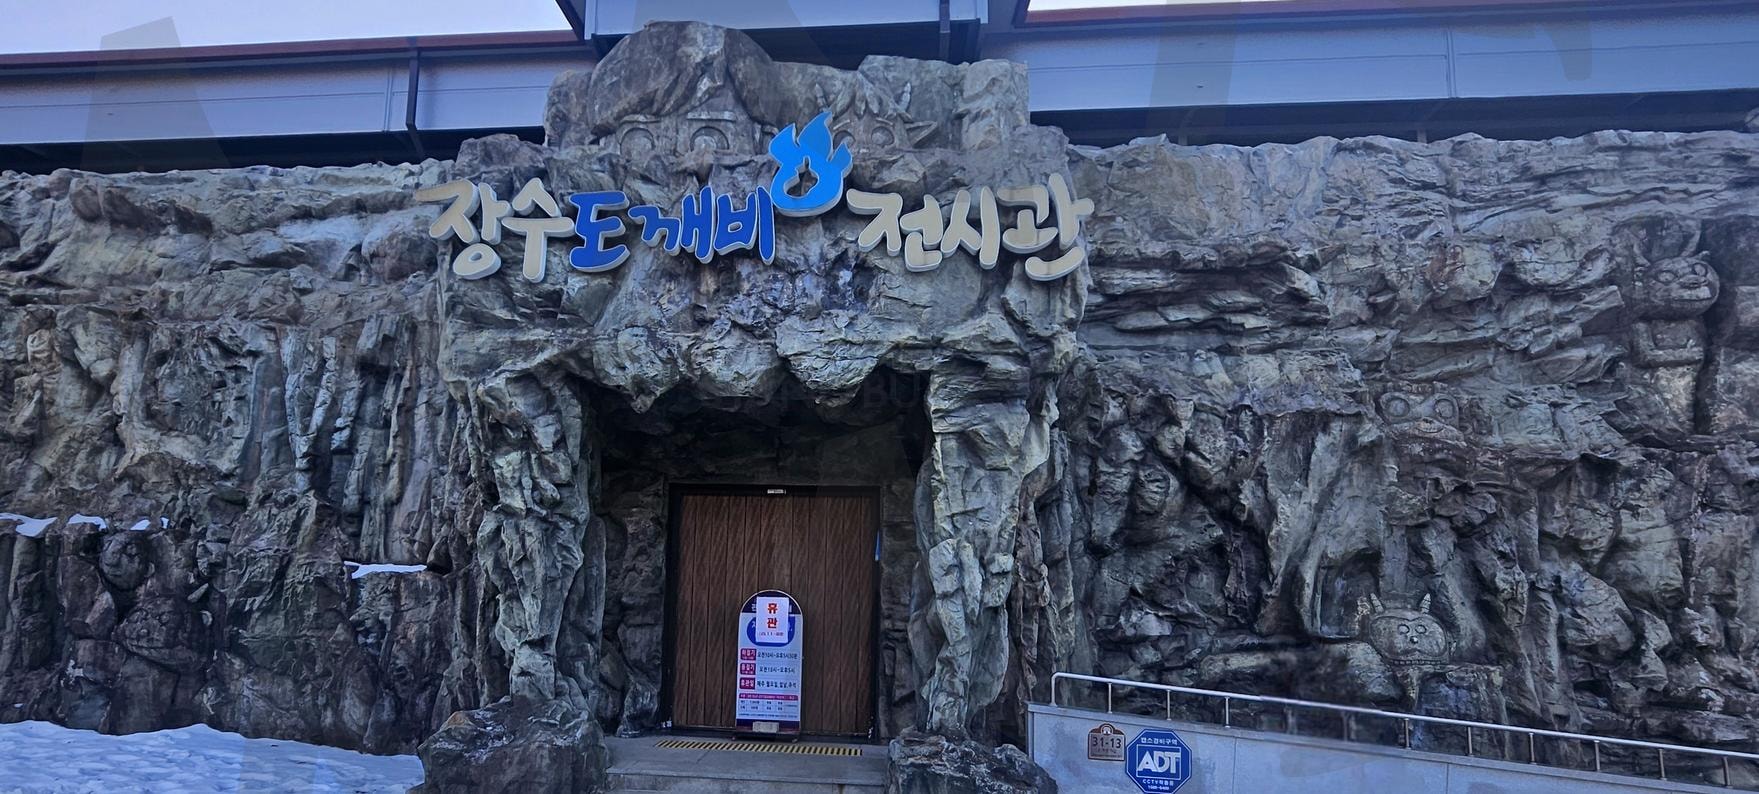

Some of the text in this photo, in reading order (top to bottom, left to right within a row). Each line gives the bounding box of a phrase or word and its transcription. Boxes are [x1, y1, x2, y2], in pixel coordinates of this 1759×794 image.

[846, 172, 1095, 282] 전시관
[767, 602, 779, 629] 휴관
[1092, 736, 1122, 749] 31-13
[1138, 750, 1181, 774] ADT
